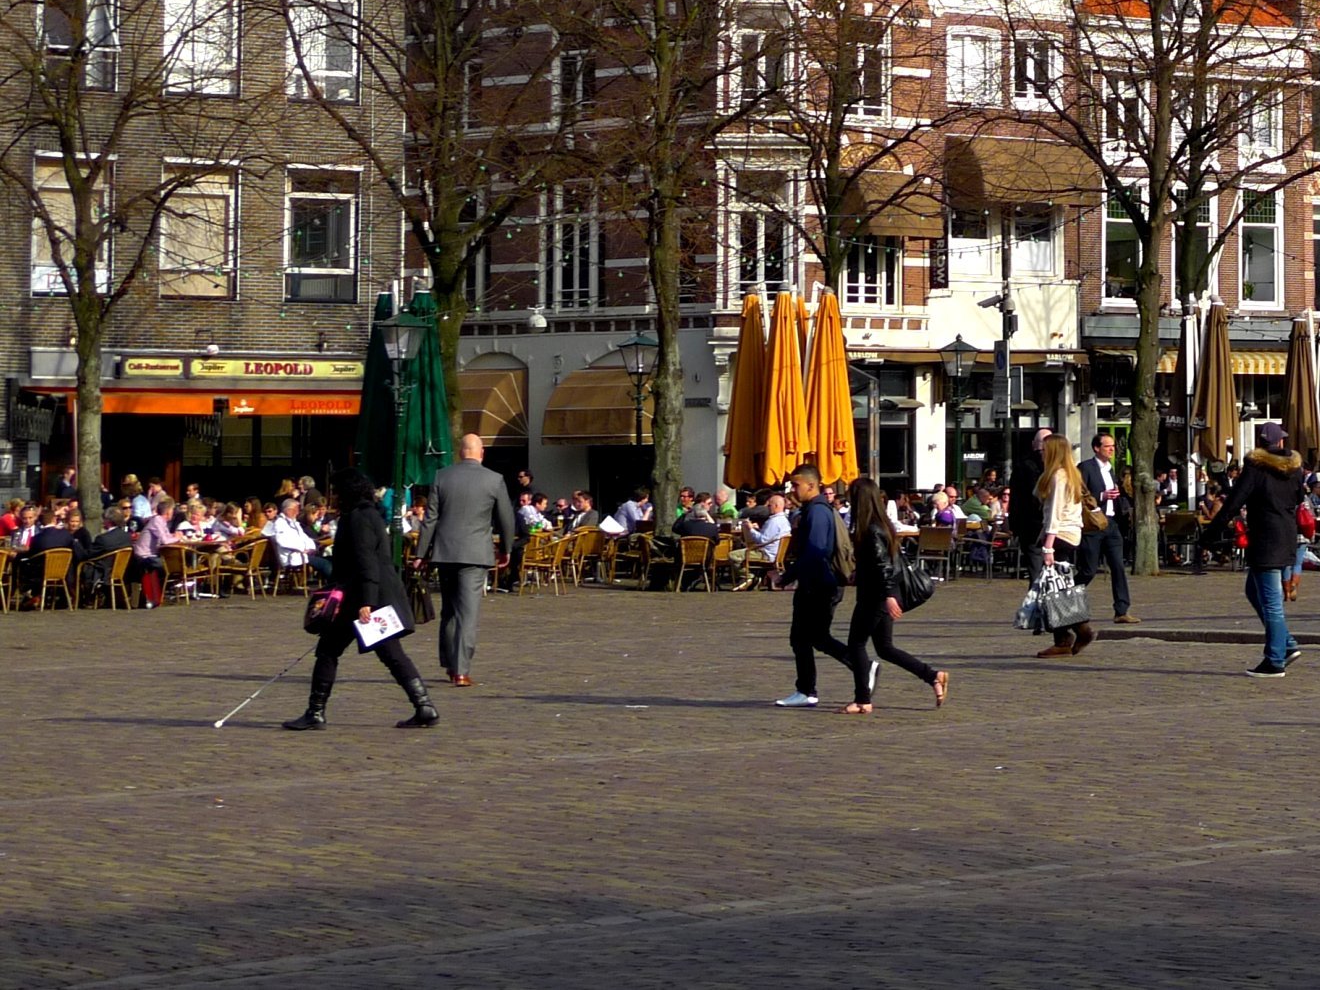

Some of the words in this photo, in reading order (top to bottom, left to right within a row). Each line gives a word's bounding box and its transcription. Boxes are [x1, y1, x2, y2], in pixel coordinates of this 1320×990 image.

[936, 239, 946, 283] RLOW
[201, 363, 226, 371] Jupiler
[244, 362, 314, 375] LEOPOLD
[332, 365, 356, 374] Jupiler
[289, 399, 353, 410] LEOPOLD
